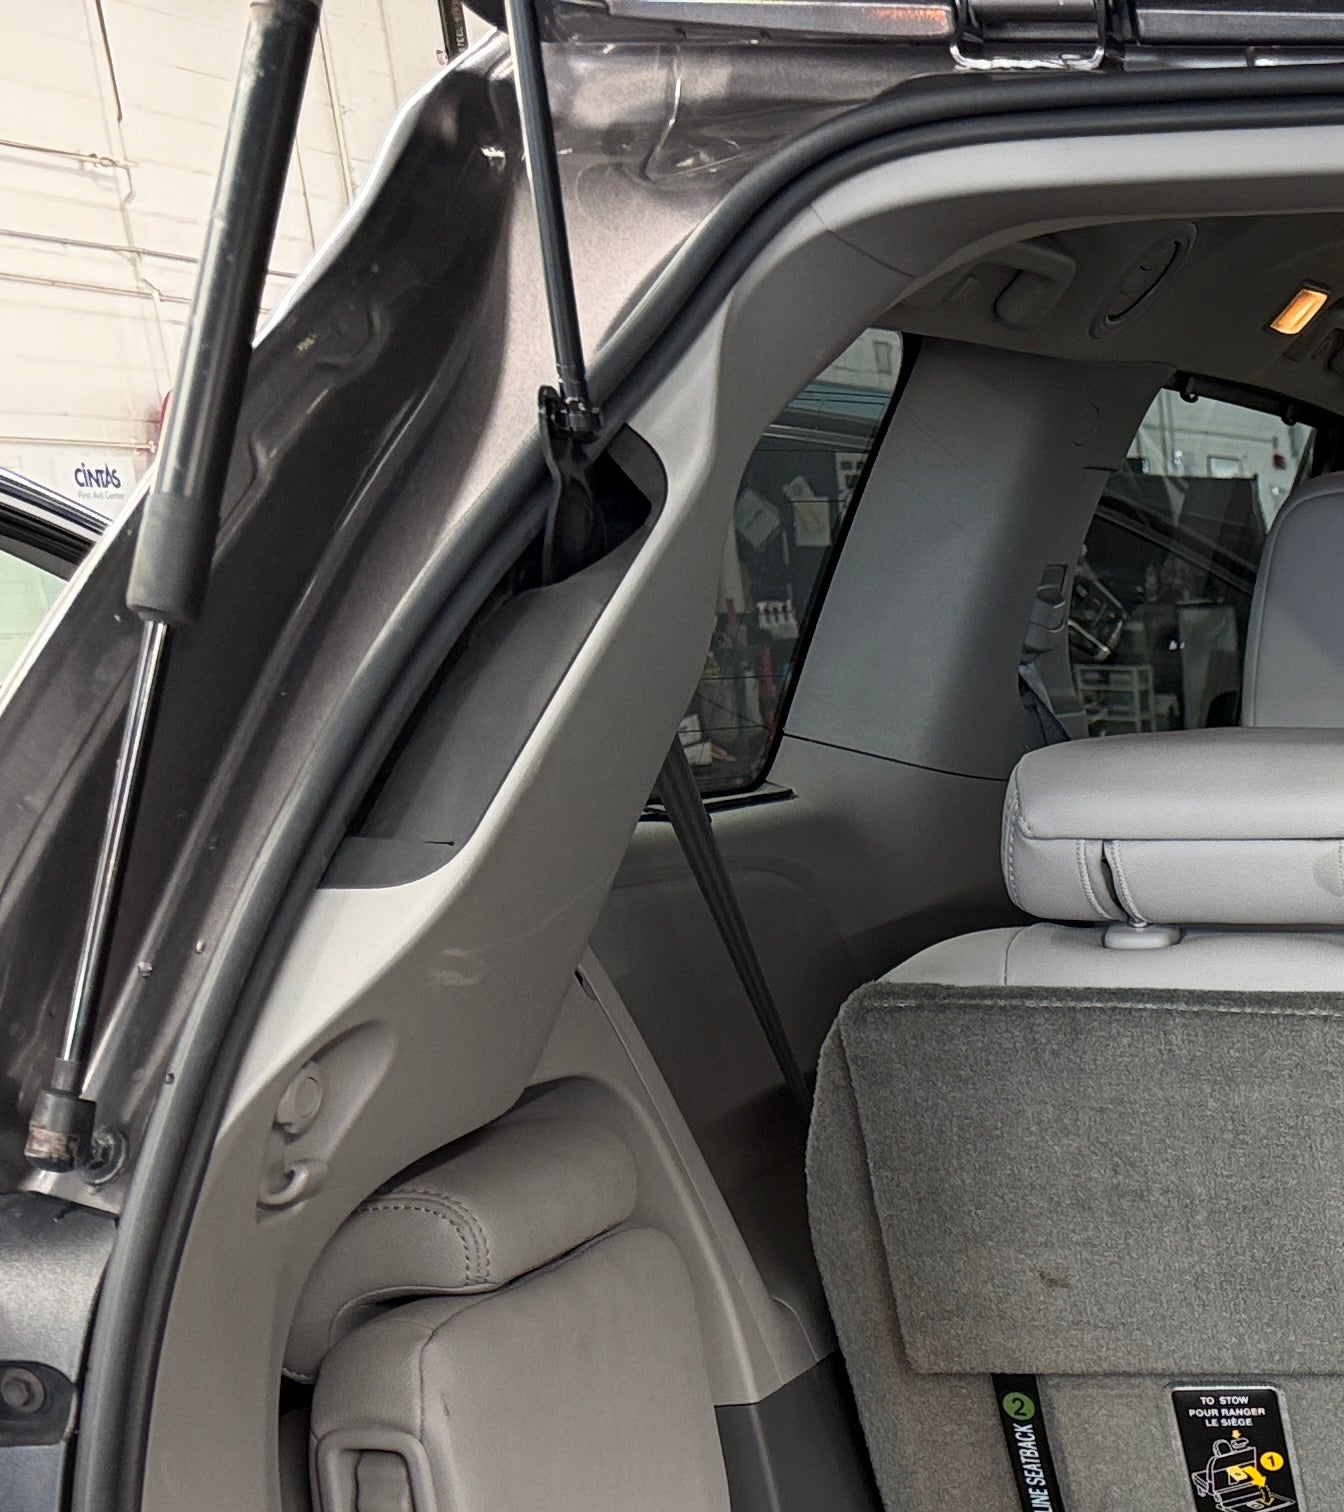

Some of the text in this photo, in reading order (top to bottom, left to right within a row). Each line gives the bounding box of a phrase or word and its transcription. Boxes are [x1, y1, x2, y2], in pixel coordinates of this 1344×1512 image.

[1010, 1396, 1028, 1417] 2
[1200, 1396, 1249, 1406] TO STOW
[1188, 1407, 1266, 1417] POUR RANGER
[1205, 1416, 1253, 1428] LE SIÈGE
[1013, 1423, 1046, 1487] SEATBACK
[1267, 1455, 1276, 1467] 1
